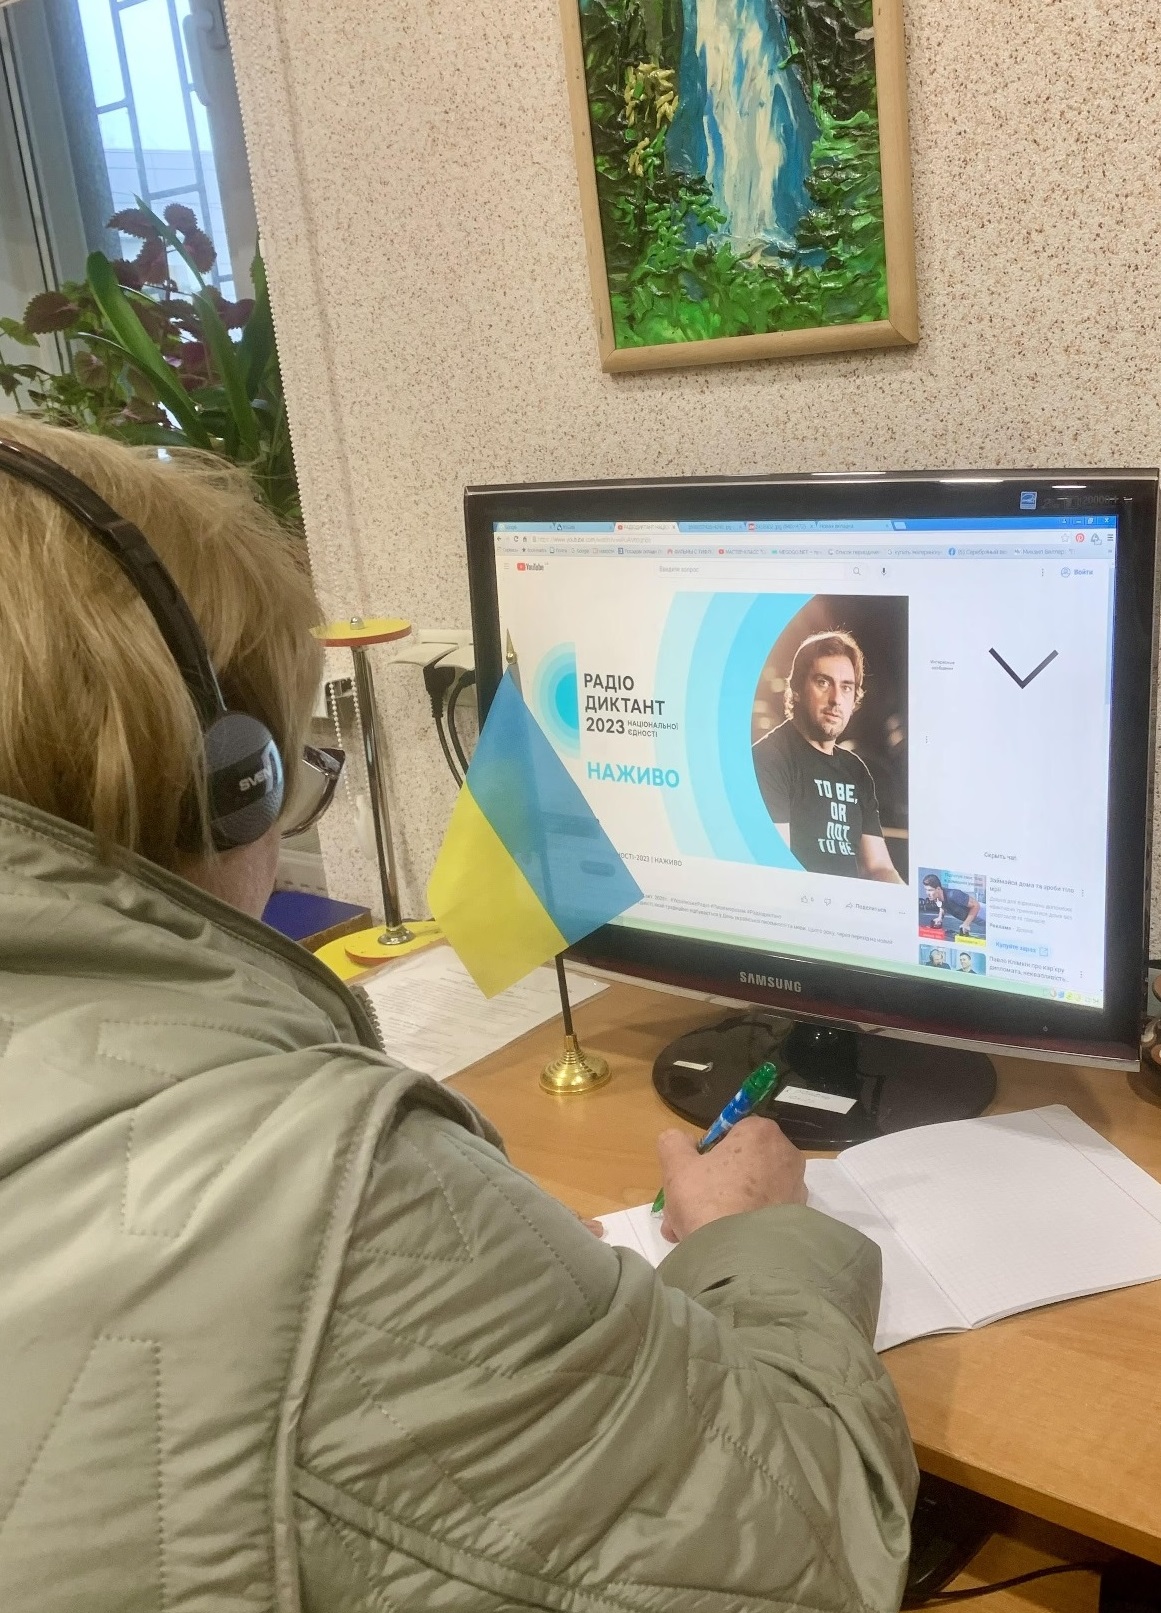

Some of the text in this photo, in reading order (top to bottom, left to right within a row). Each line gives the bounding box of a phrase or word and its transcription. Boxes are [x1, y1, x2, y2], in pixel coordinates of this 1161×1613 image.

[526, 563, 544, 571] YouTube
[584, 673, 634, 693] РАДІО
[585, 695, 665, 716] ДИКТАНТ
[586, 717, 625, 734] 2023
[628, 720, 679, 730] НАЦІОНАЛЬНОЇ
[588, 761, 680, 788] НАЖИВО
[814, 779, 832, 798] TO
[830, 802, 846, 822] OR
[818, 838, 836, 854] TO
[654, 856, 682, 867] НАЖИВО
[984, 852, 1006, 860] Скрыть
[990, 878, 1018, 886] Займайся
[856, 904, 887, 912] Поделиться
[996, 941, 1019, 950] Купуйте
[740, 971, 802, 992] SAMSUNG
